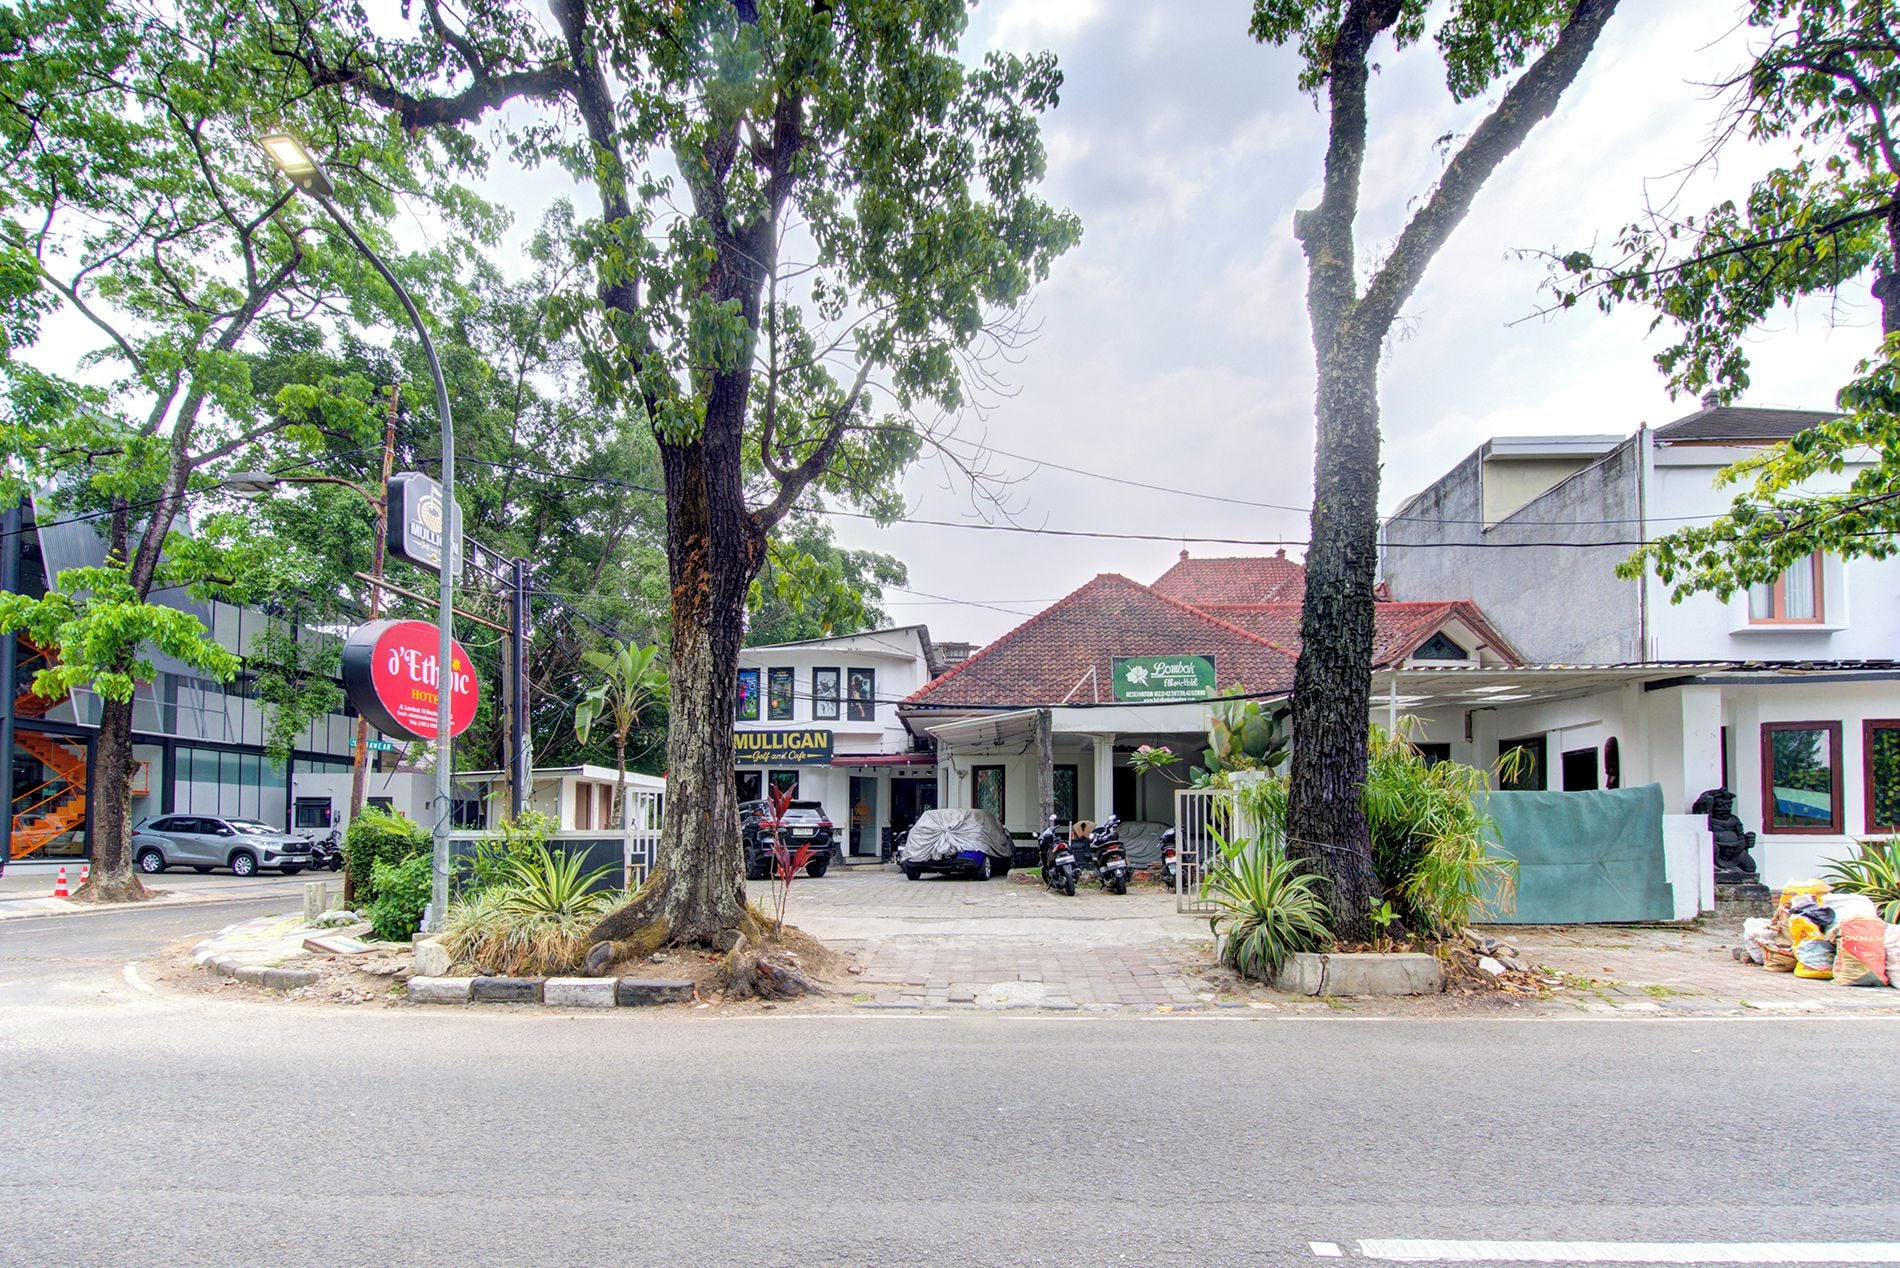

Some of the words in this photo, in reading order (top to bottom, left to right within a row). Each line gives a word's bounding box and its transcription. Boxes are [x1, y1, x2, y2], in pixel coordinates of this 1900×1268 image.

[410, 521, 459, 555] MULLIN
[388, 646, 469, 694] d'Ethic
[1151, 661, 1195, 676] Lombok
[411, 688, 439, 704] HOTE
[733, 732, 828, 749] MULLIGAN
[752, 750, 771, 762] Golf
[771, 752, 787, 760] and
[788, 750, 807, 761] Cafe
